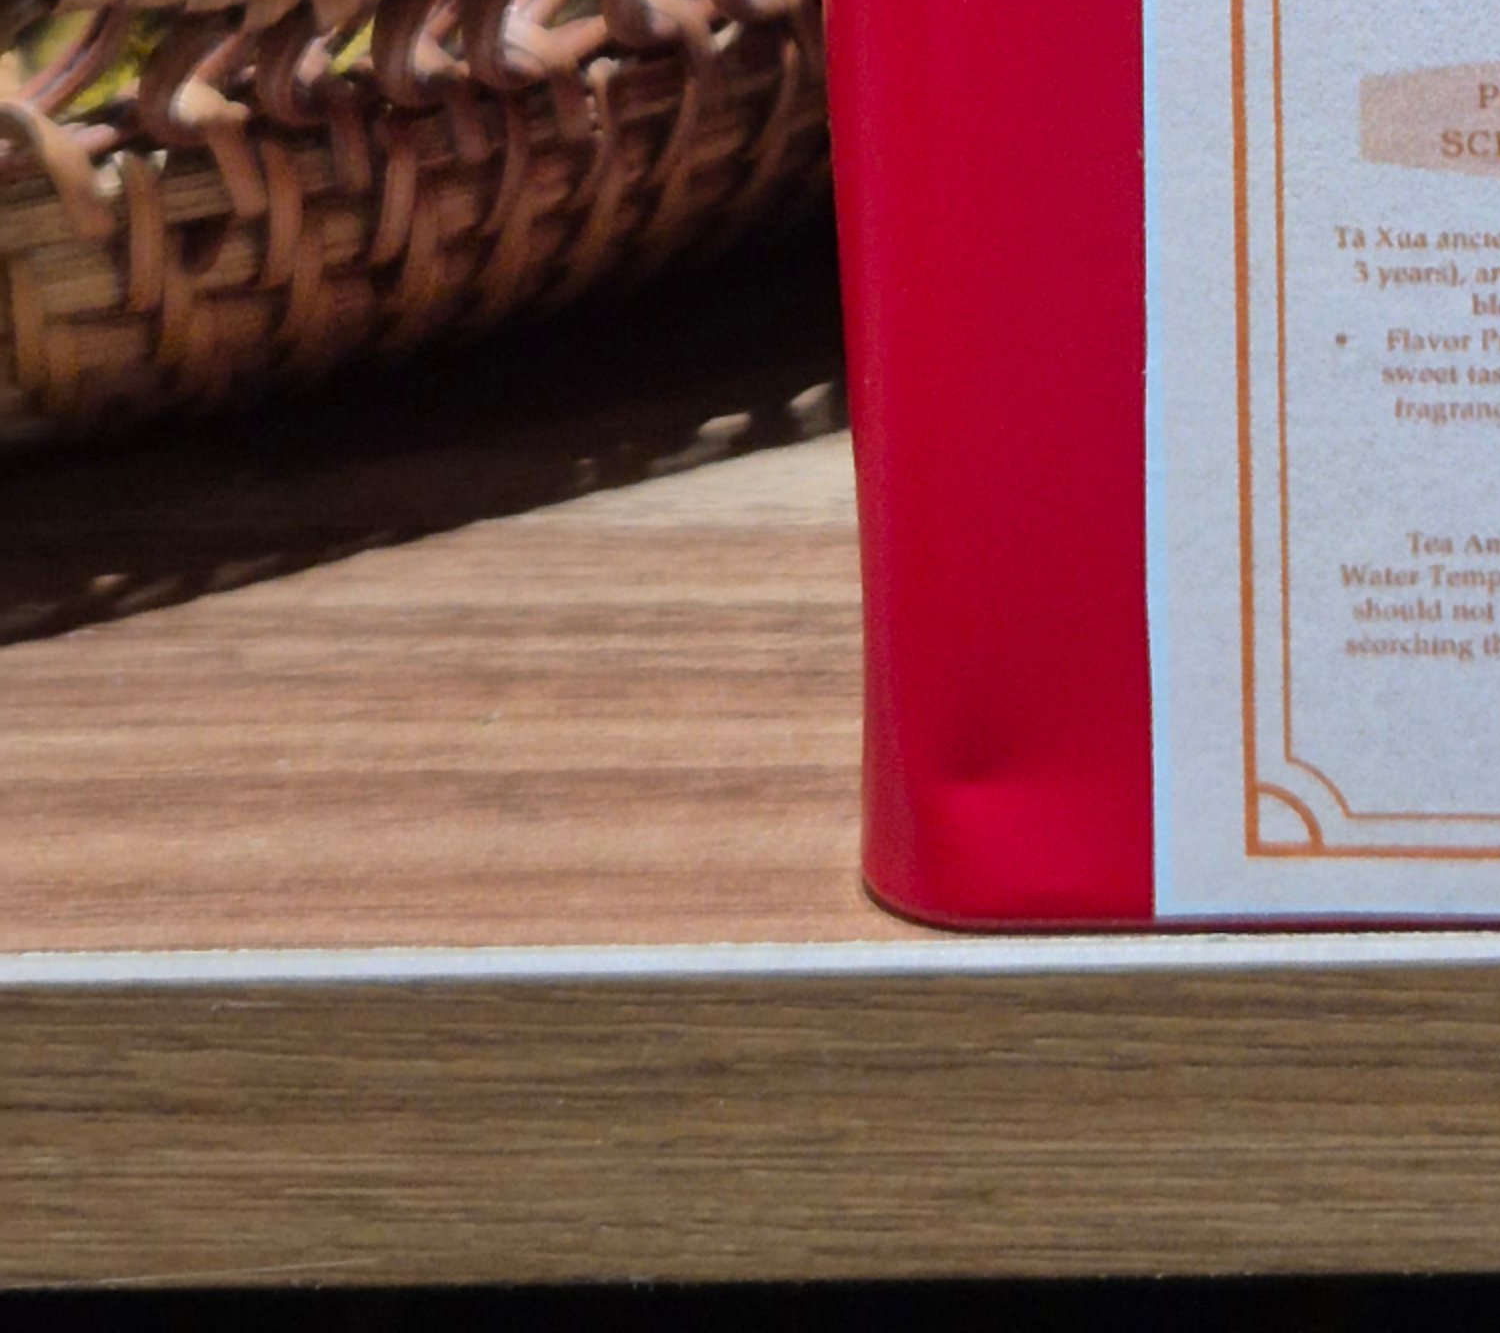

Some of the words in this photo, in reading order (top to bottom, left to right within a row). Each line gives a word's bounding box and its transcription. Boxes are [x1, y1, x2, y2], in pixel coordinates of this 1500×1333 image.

[1387, 327, 1470, 352] Flavor
[1382, 360, 1457, 385] sweet
[1407, 531, 1453, 556] Tea
[1340, 563, 1419, 588] Water
[1352, 597, 1442, 622] should
[1452, 598, 1494, 623] not
[1345, 631, 1473, 663] scorching
